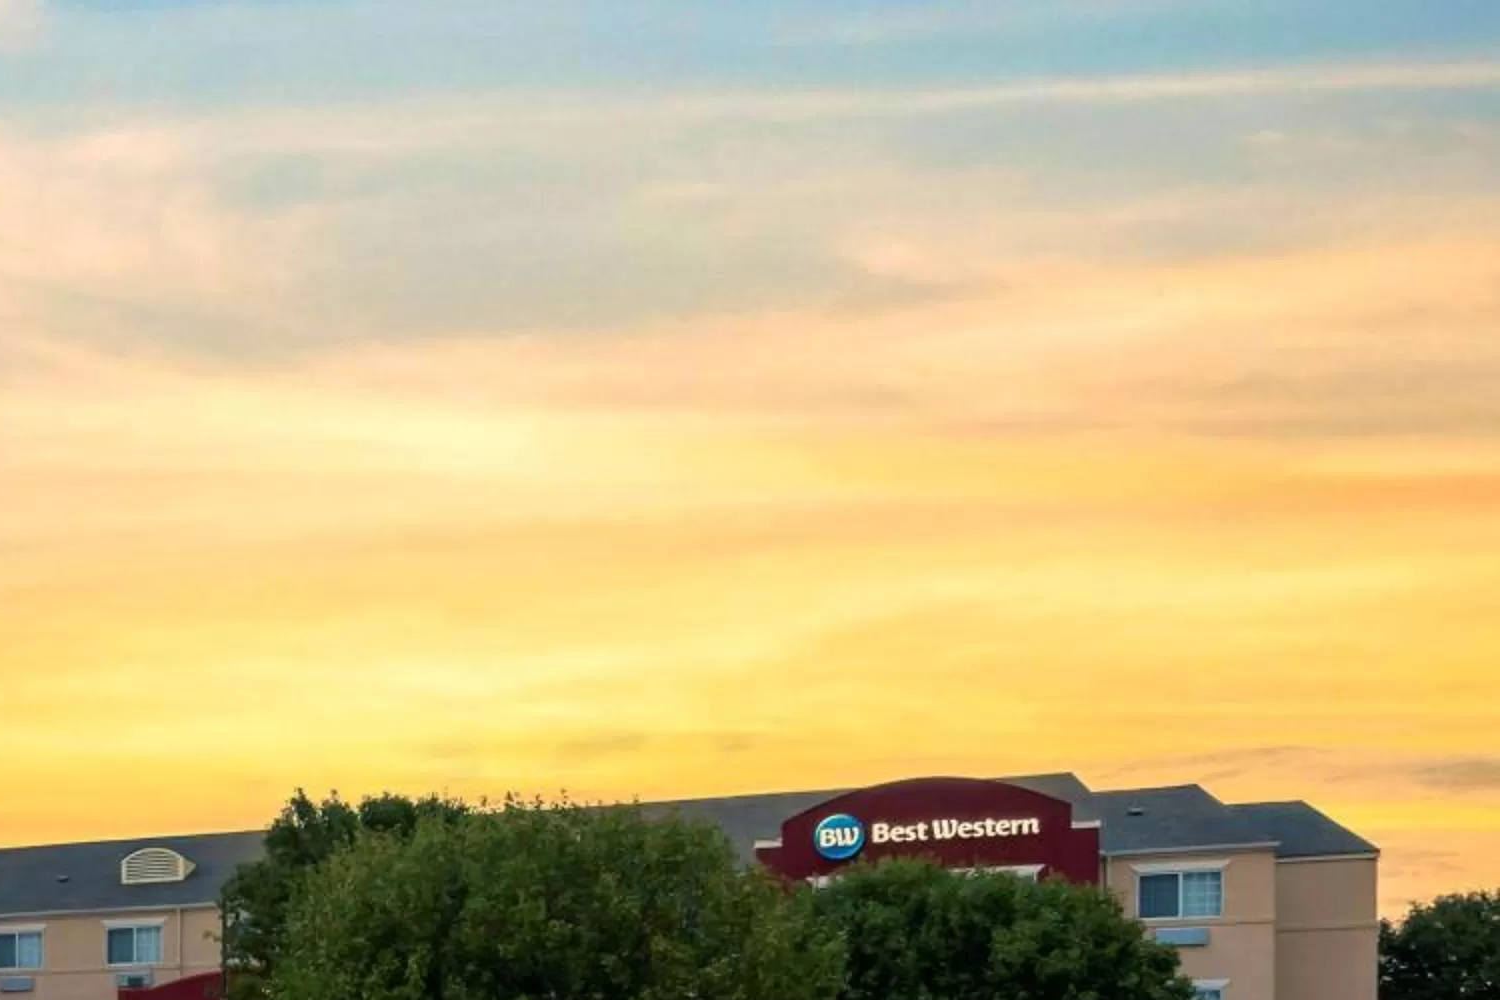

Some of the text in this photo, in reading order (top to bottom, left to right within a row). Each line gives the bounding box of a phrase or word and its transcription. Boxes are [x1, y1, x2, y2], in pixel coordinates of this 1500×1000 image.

[819, 818, 1039, 847] BW Best Western
